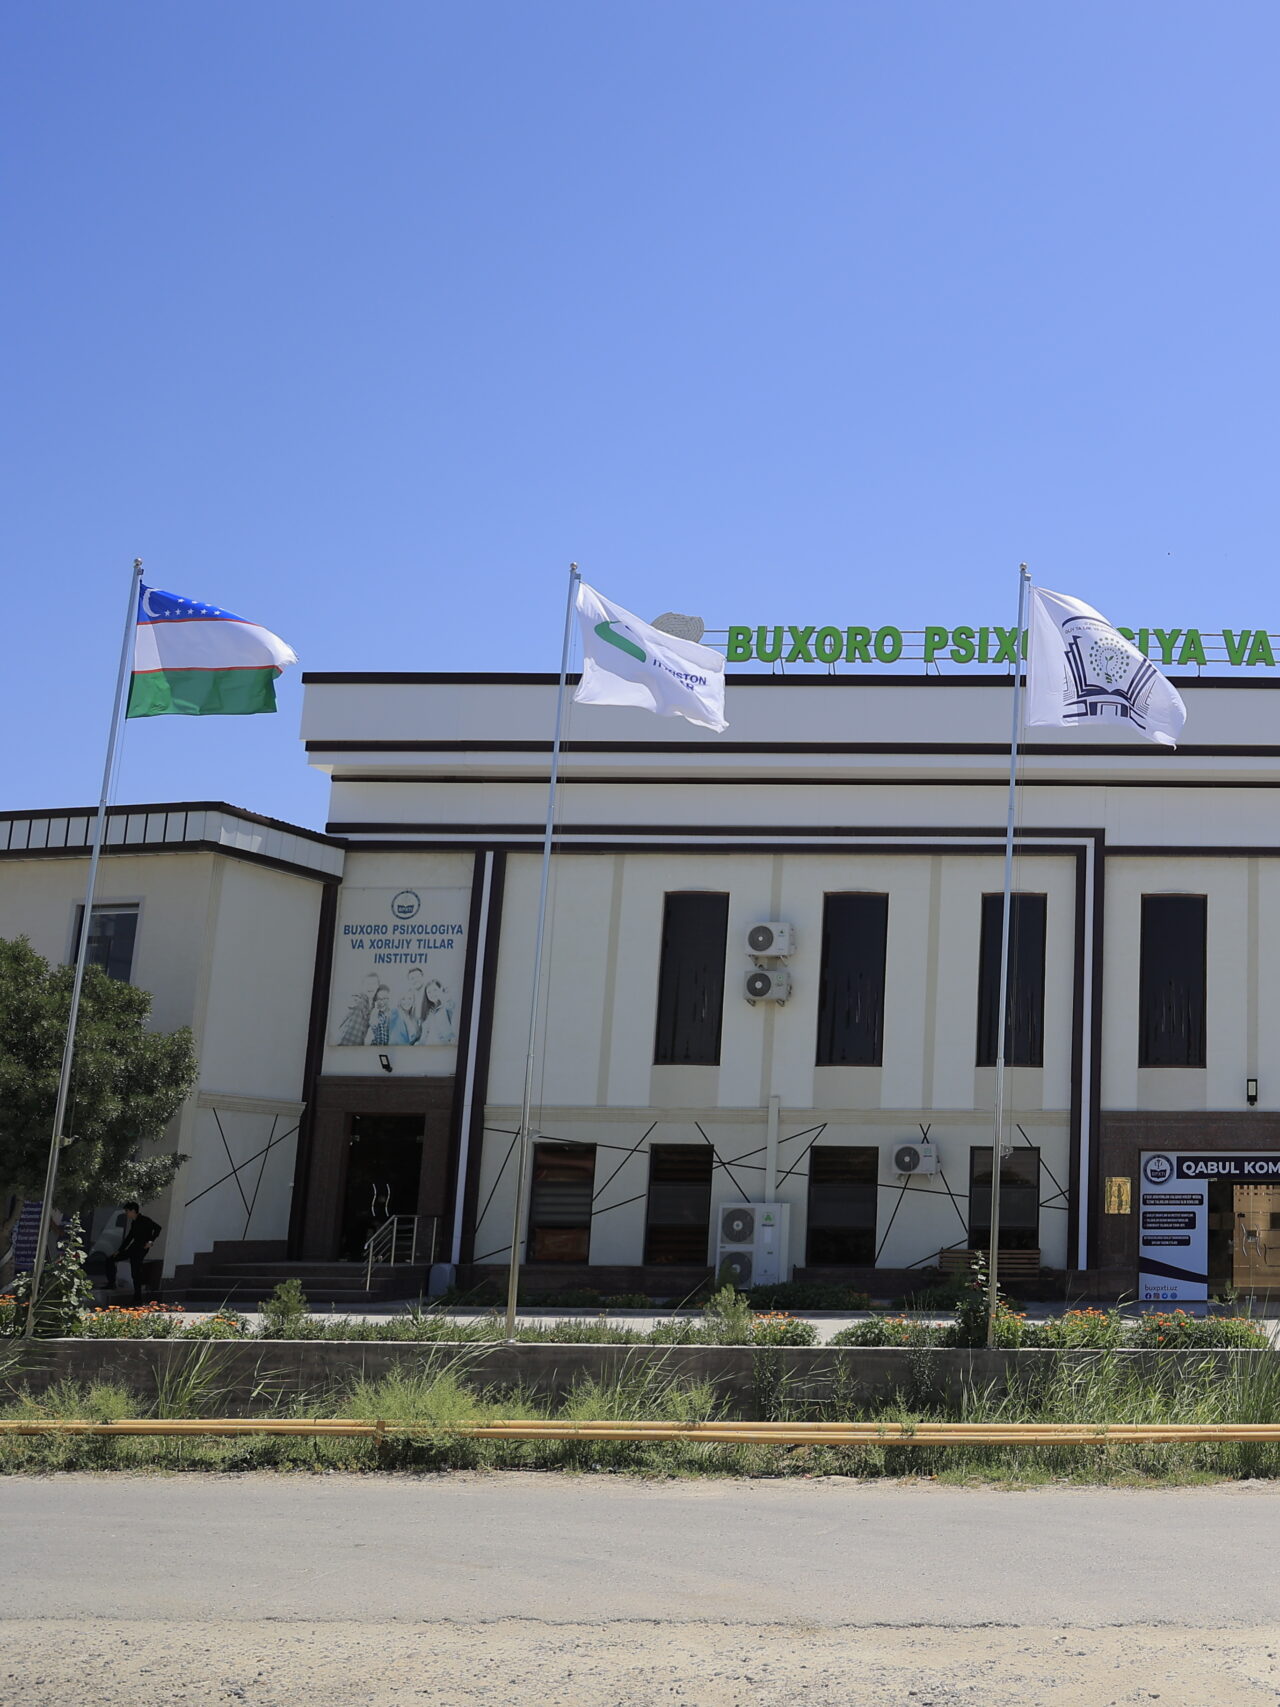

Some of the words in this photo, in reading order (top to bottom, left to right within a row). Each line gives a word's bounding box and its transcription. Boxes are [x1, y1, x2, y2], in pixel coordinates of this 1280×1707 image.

[726, 625, 903, 664] BUXORO
[1223, 629, 1275, 667] VA
[343, 924, 388, 936] BUXORO
[392, 924, 463, 936] PSIXOLOGIYA
[351, 938, 365, 950] VA
[369, 938, 412, 950] XORIJIY
[417, 939, 454, 950] TILLAR
[374, 953, 428, 964] INSTITUTI
[1182, 1161, 1239, 1176] QABUL
